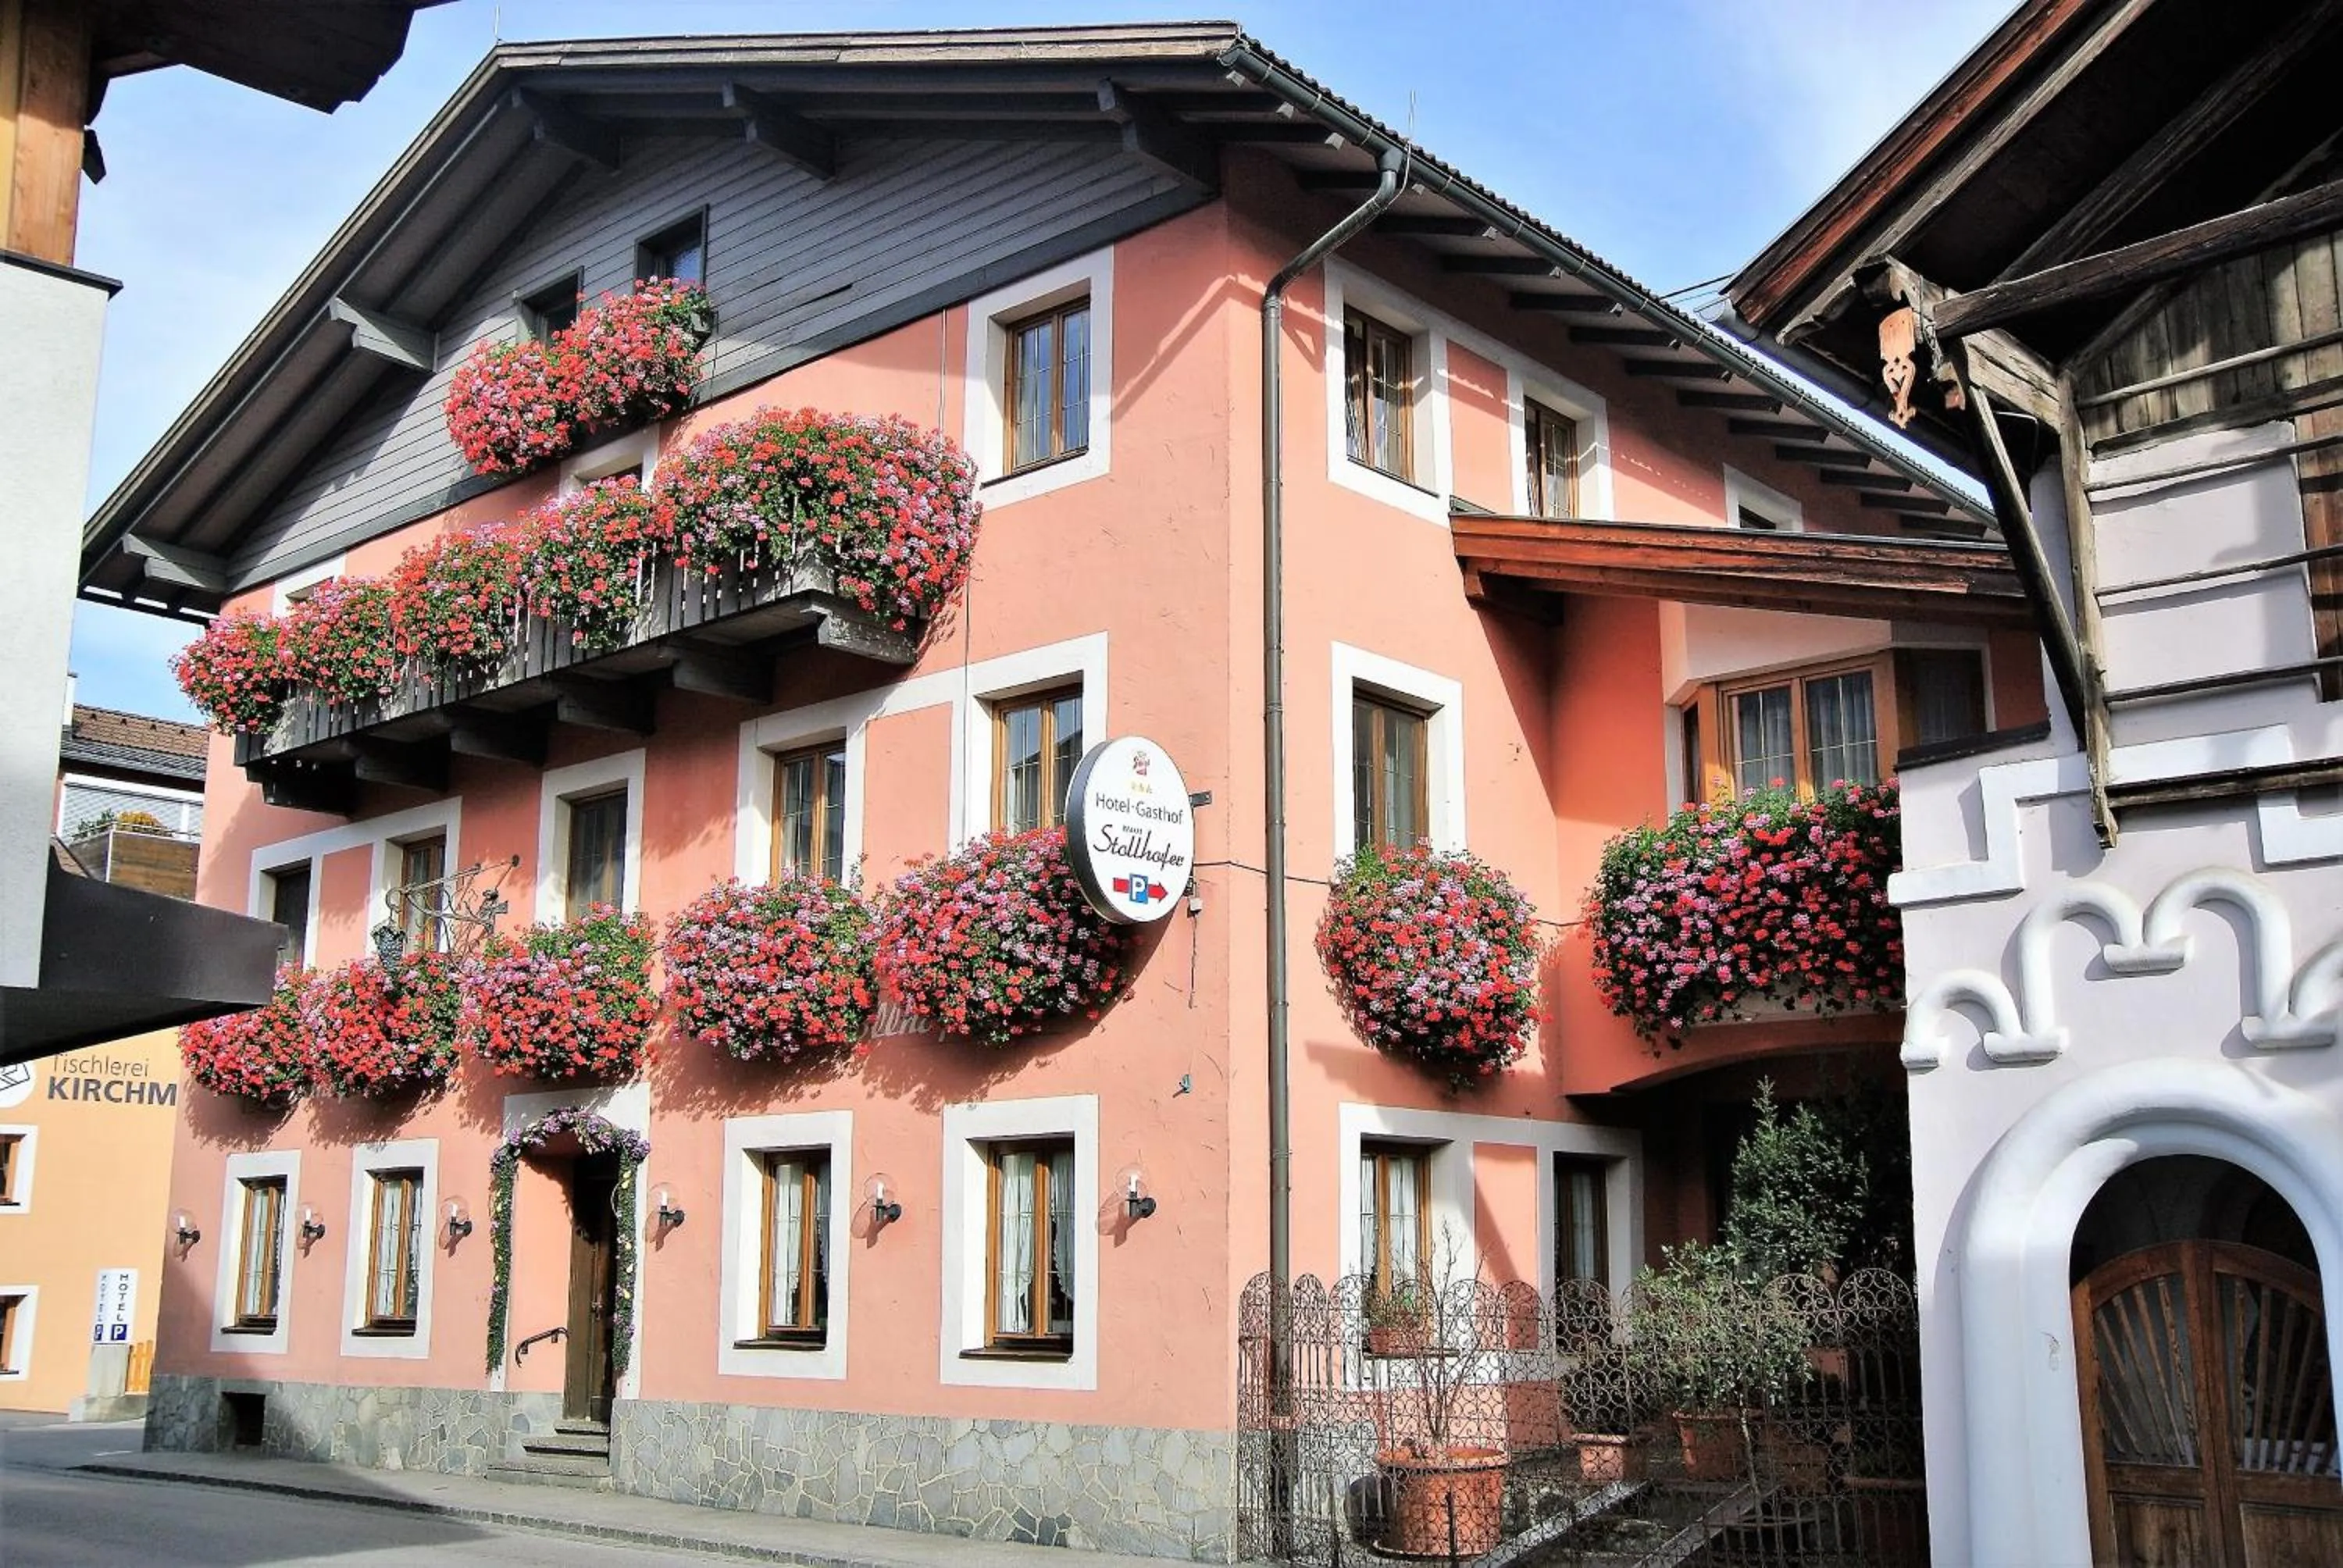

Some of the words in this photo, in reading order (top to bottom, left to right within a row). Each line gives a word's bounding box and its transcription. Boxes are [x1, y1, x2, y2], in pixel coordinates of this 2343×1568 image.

[1093, 824, 1185, 871] Stollhofer
[1132, 876, 1147, 901] P
[52, 1053, 150, 1078] Tischlerei
[47, 1076, 177, 1107] KIRCHM
[116, 1274, 129, 1322] MOTEL
[112, 1325, 125, 1340] P
